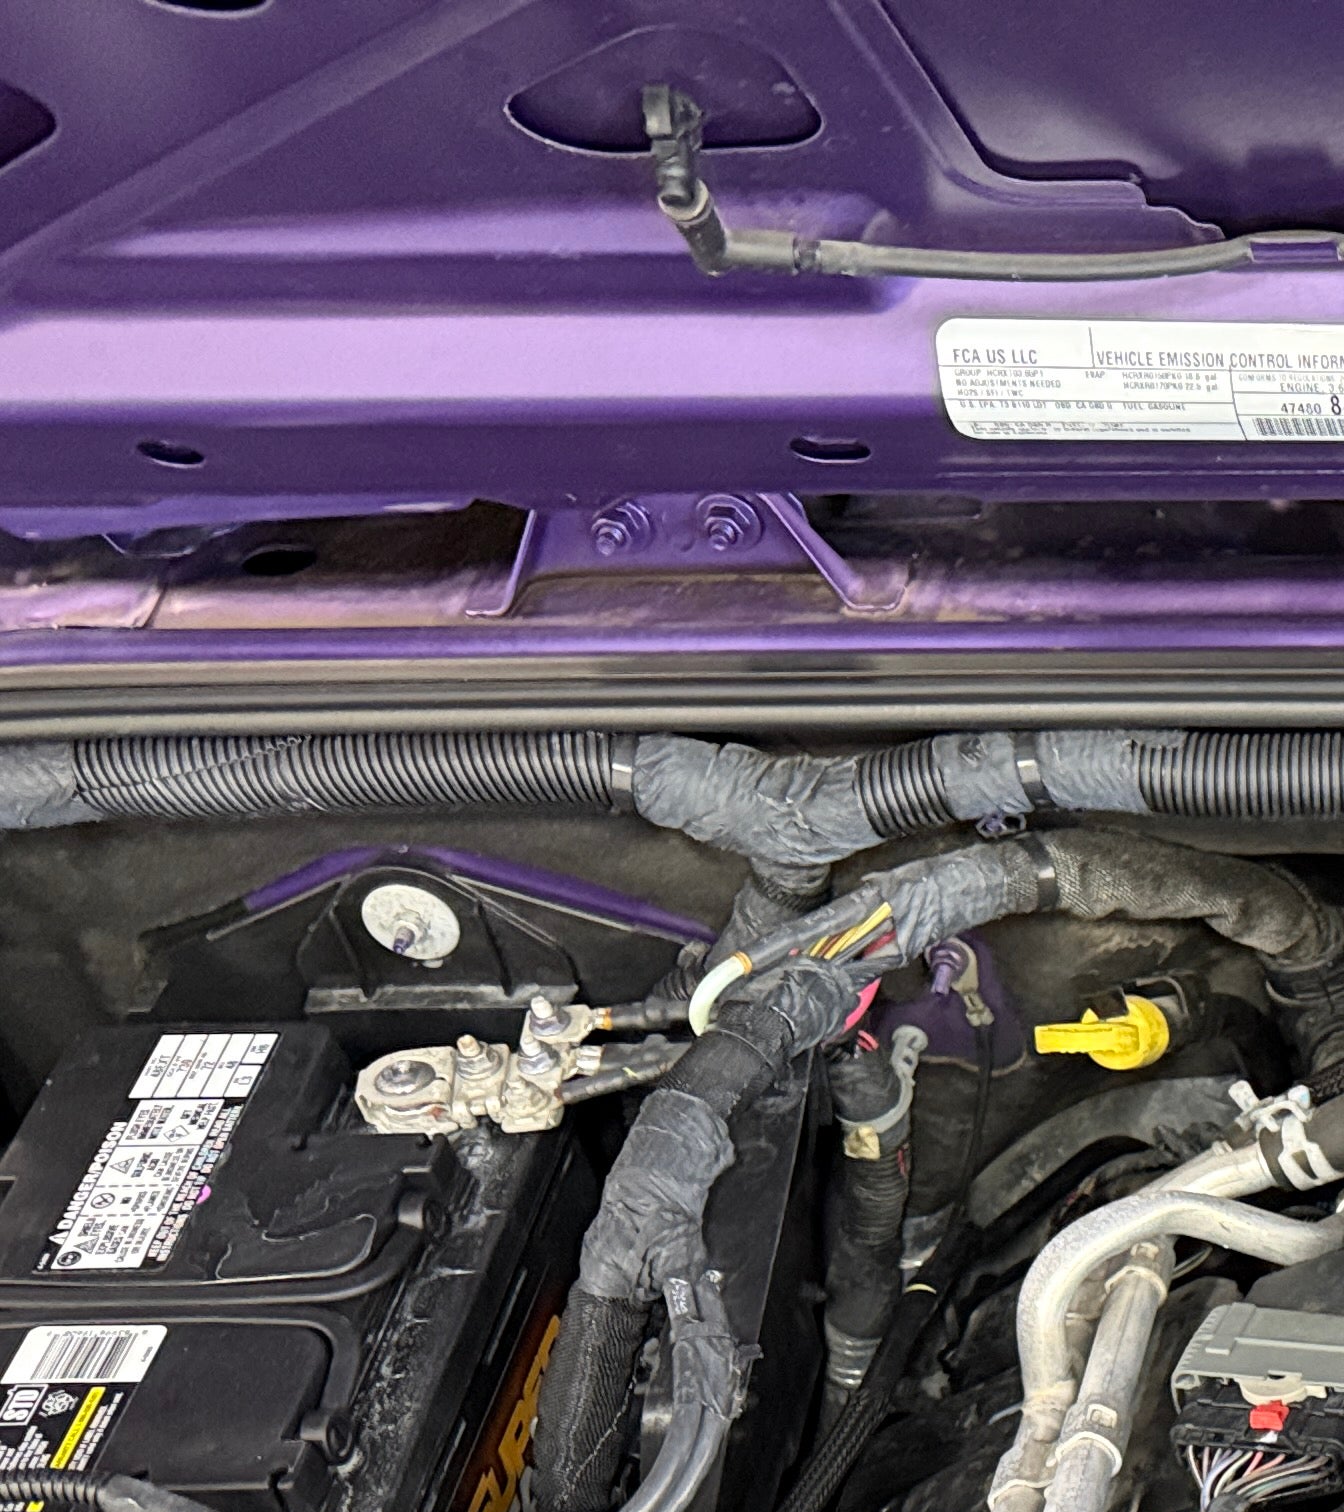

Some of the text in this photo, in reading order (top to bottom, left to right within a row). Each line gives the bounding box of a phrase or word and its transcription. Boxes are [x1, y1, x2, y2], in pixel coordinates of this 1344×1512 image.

[953, 348, 1038, 364] FCA US LLC
[1097, 352, 1153, 366] VEHICLE
[1159, 352, 1224, 368] EMISSION
[1230, 353, 1293, 368] CONTROL
[1280, 402, 1322, 415] 47480
[56, 1120, 128, 1229] DANGER/POISON
[3, 1389, 40, 1421] STD
